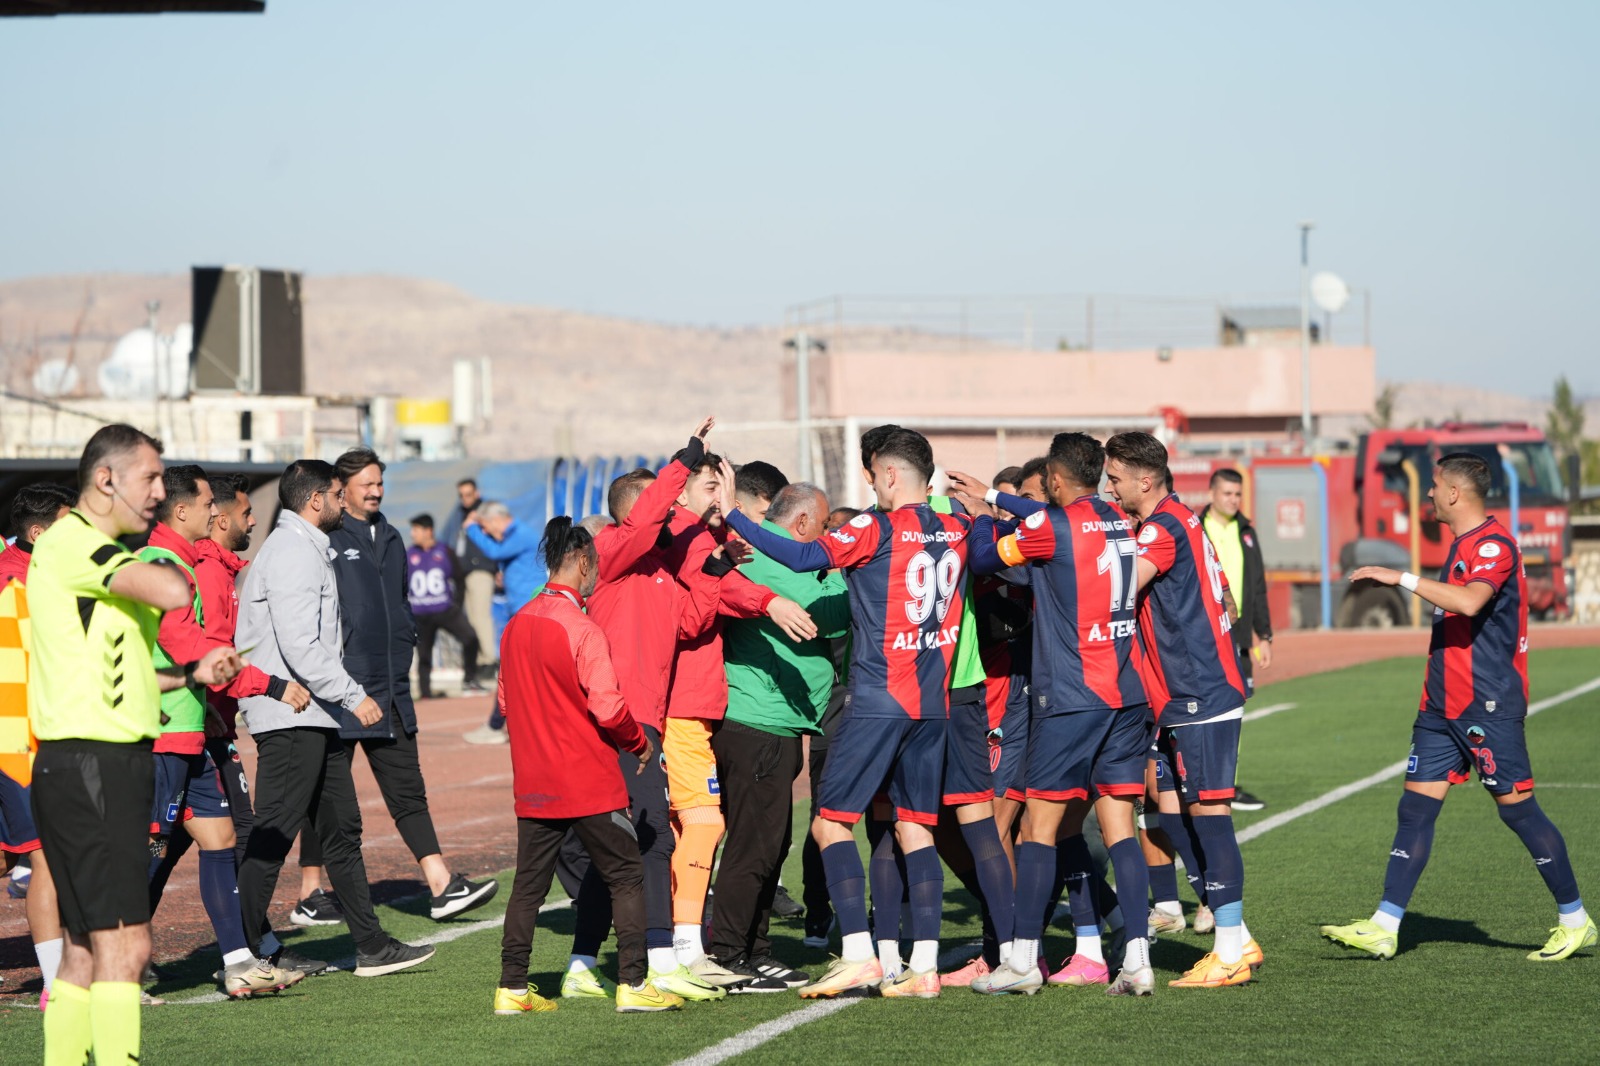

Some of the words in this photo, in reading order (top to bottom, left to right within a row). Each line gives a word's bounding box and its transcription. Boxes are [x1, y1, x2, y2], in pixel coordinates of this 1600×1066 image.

[1082, 520, 1114, 533] DUYAN
[410, 568, 446, 597] 06
[905, 549, 961, 624] 99
[1096, 537, 1137, 612] 17
